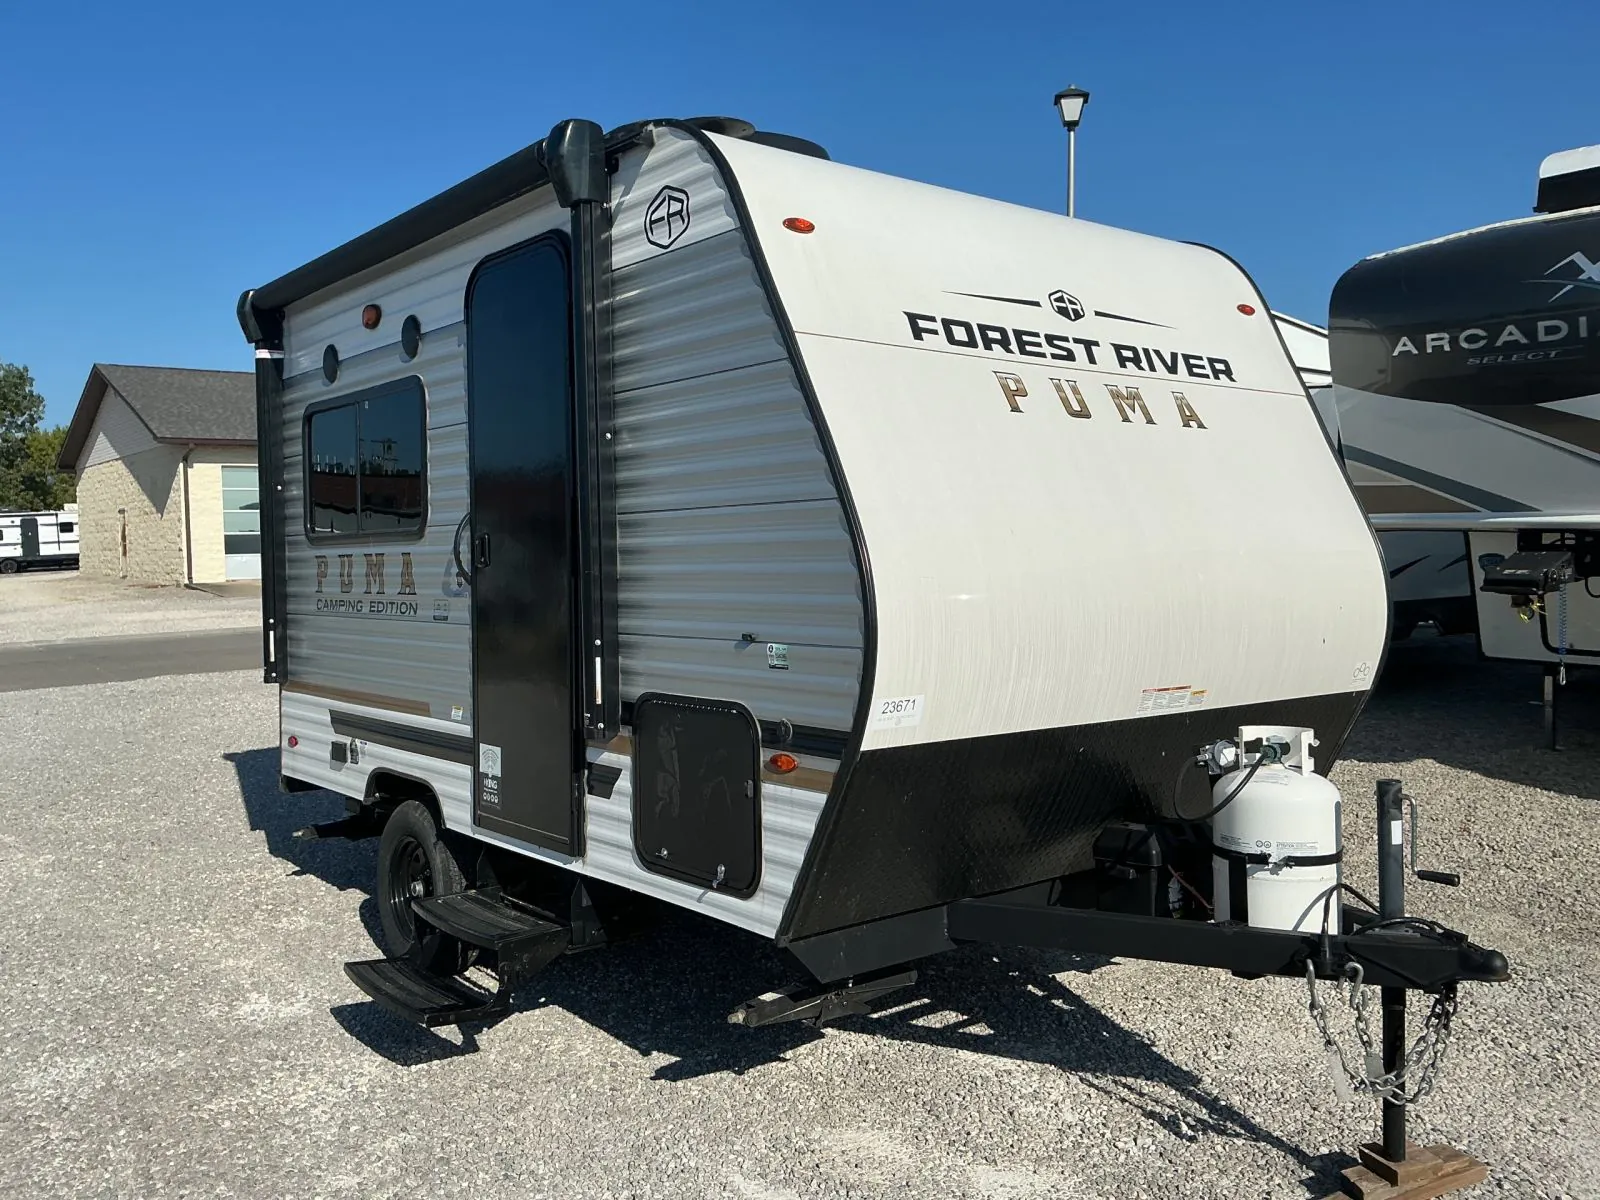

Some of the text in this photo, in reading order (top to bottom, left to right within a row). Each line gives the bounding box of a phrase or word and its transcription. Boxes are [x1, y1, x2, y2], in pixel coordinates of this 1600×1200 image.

[902, 311, 1238, 382] FOREST RIVER
[1392, 315, 1600, 357] ARCADI
[1466, 350, 1563, 366] SELECT
[992, 370, 1209, 430] PUMA
[315, 552, 417, 596] PUMA
[316, 598, 364, 613] CAMPING
[368, 600, 418, 616] EDITION
[881, 698, 917, 715] 23671
